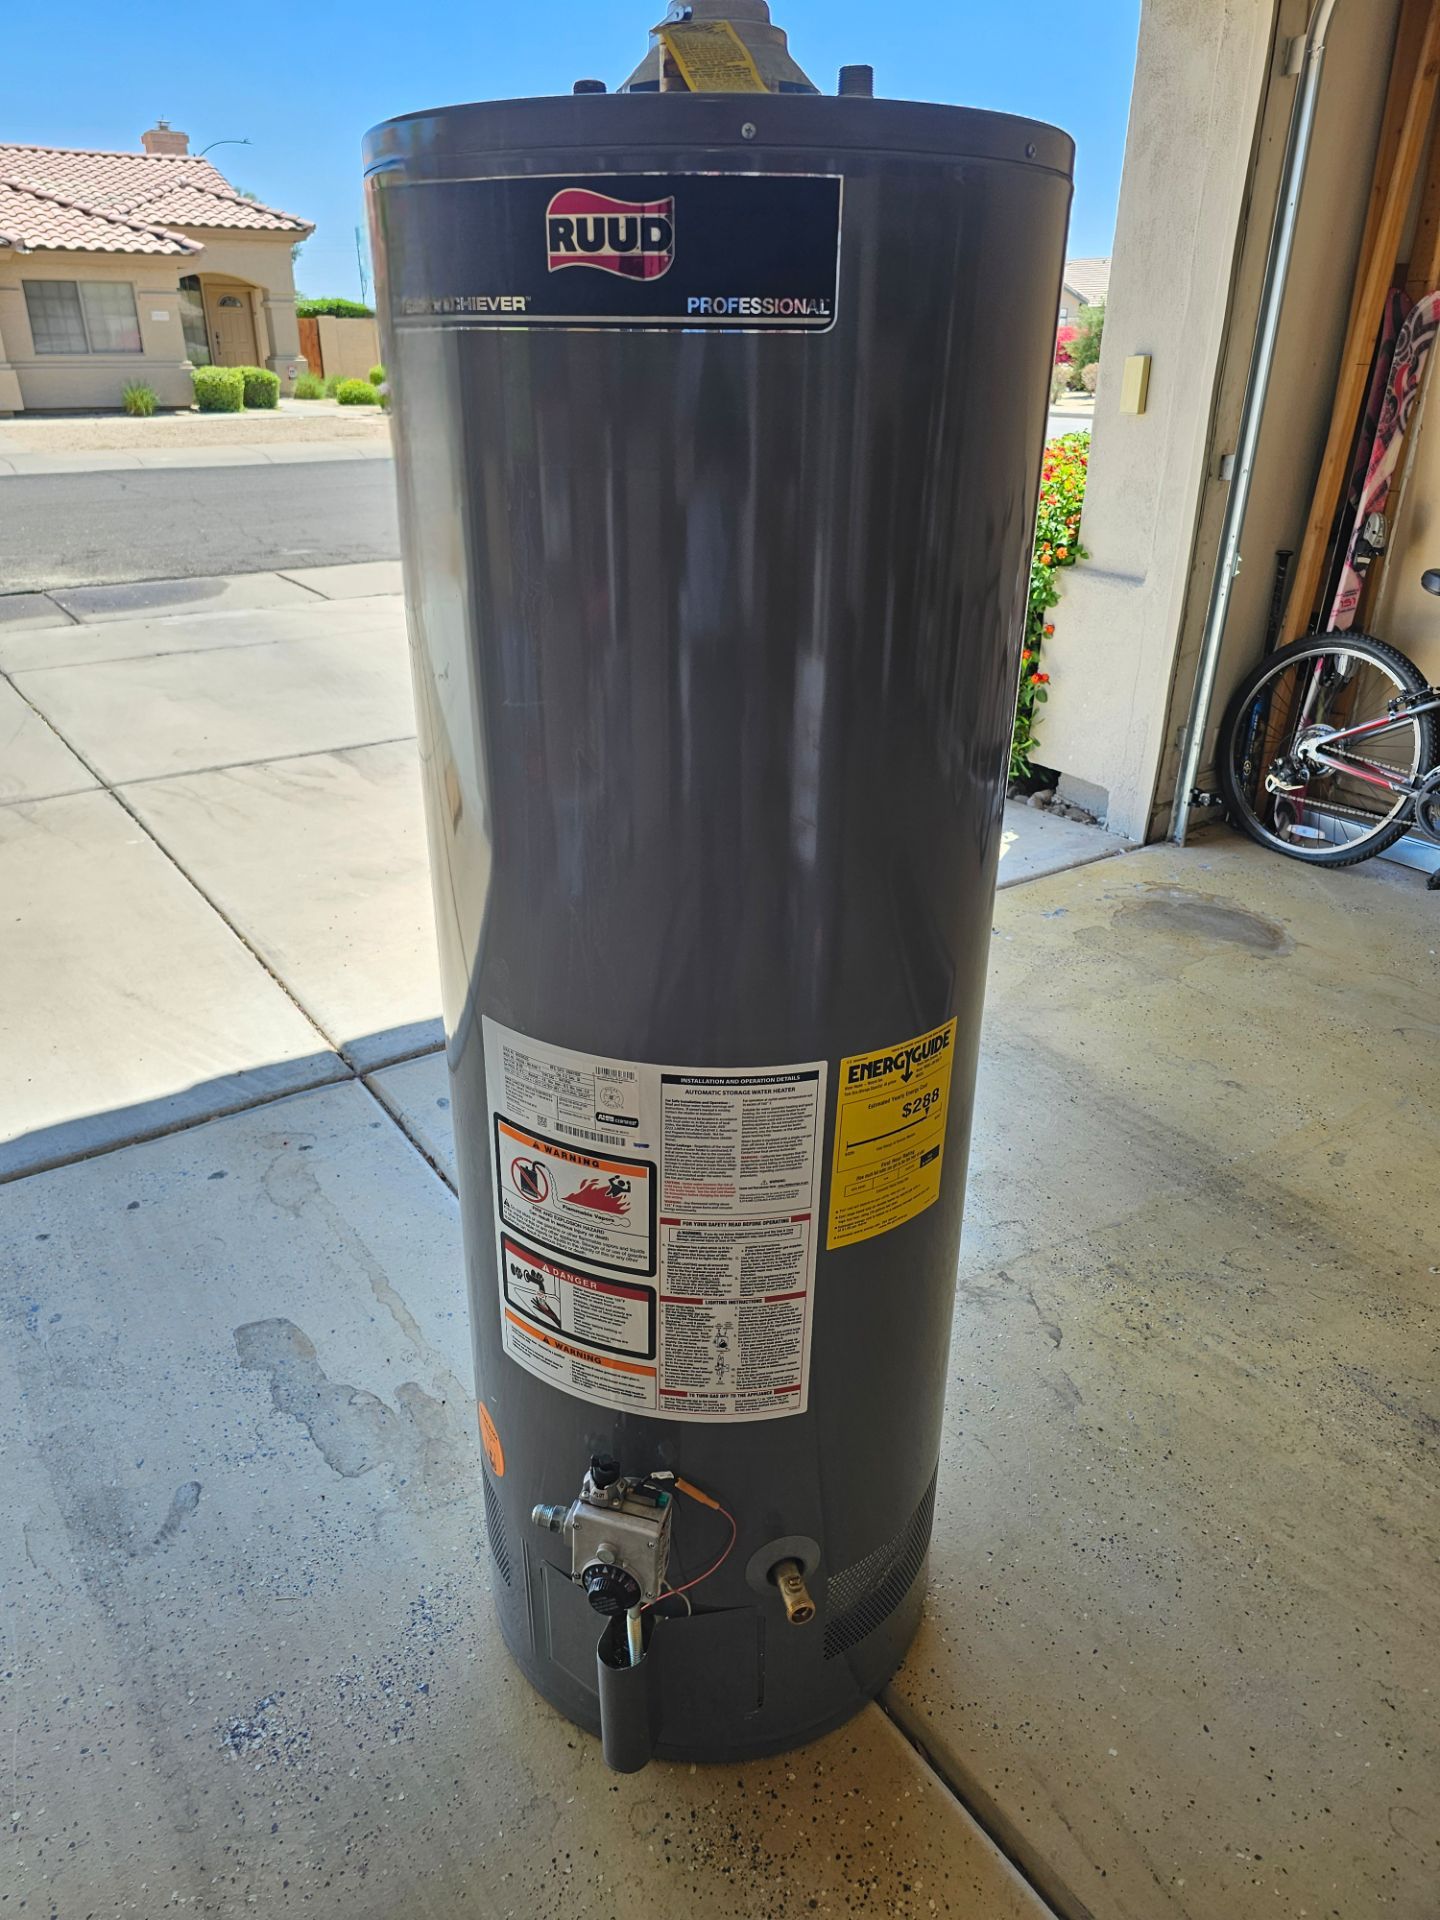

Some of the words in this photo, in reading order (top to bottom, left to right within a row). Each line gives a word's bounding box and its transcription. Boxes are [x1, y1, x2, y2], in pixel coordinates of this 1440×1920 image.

[548, 217, 672, 253] RUUD
[687, 297, 830, 315] PROFESSIONAL
[776, 1074, 801, 1082] DETAILS
[868, 1098, 891, 1109] Estimated
[901, 1087, 940, 1118] $288
[544, 1144, 600, 1168] WARNING
[554, 1215, 582, 1228] EXPLOSION
[562, 1204, 593, 1217] Flammable
[594, 1213, 615, 1222] Vapors
[762, 1218, 790, 1226] OPERATING
[552, 1267, 598, 1290] DANGER
[555, 1341, 602, 1365] WARNING
